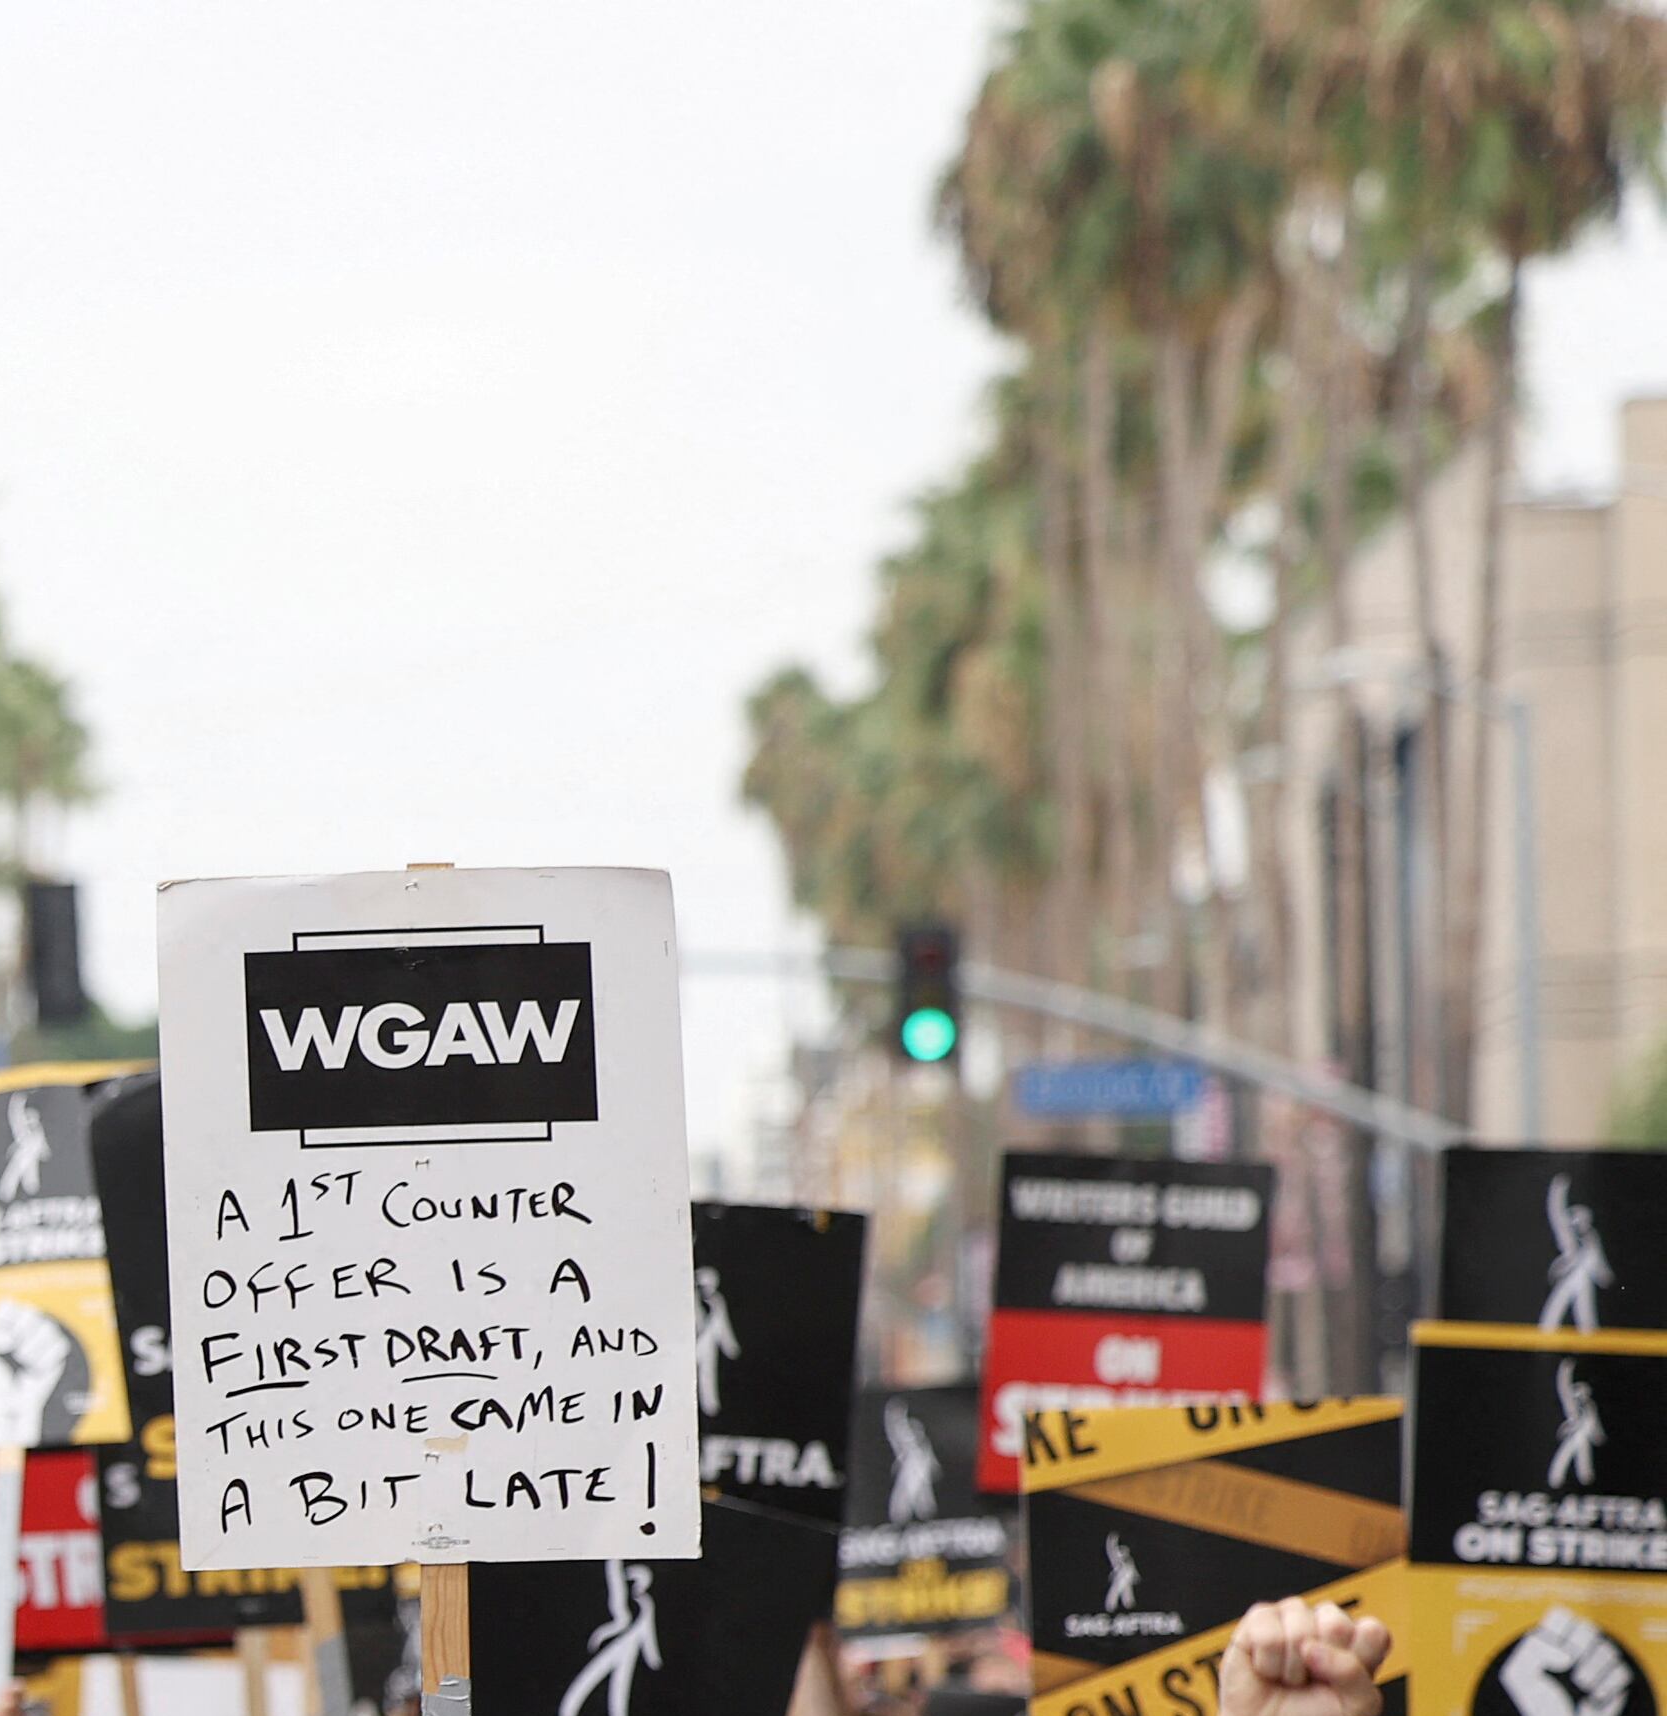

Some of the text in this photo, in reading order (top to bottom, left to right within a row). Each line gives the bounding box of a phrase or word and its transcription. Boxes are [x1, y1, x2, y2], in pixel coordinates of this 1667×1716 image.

[259, 999, 581, 1072] WGAW
[217, 1170, 593, 1241] A 1ST COUNTER
[203, 1257, 591, 1313] OFFER IS A
[200, 1332, 368, 1384] FIRST
[383, 1325, 545, 1370] DRAFT,
[571, 1325, 659, 1358] AND
[1093, 1332, 1163, 1386] ON
[205, 1409, 315, 1454] THIS
[337, 1403, 429, 1433] ONE
[450, 1384, 587, 1433] CAME
[614, 1383, 664, 1423] IN
[220, 1477, 252, 1534] A
[289, 1470, 422, 1526] BIT
[465, 1441, 657, 1536] LATE!
[1453, 1521, 1524, 1563] ON
